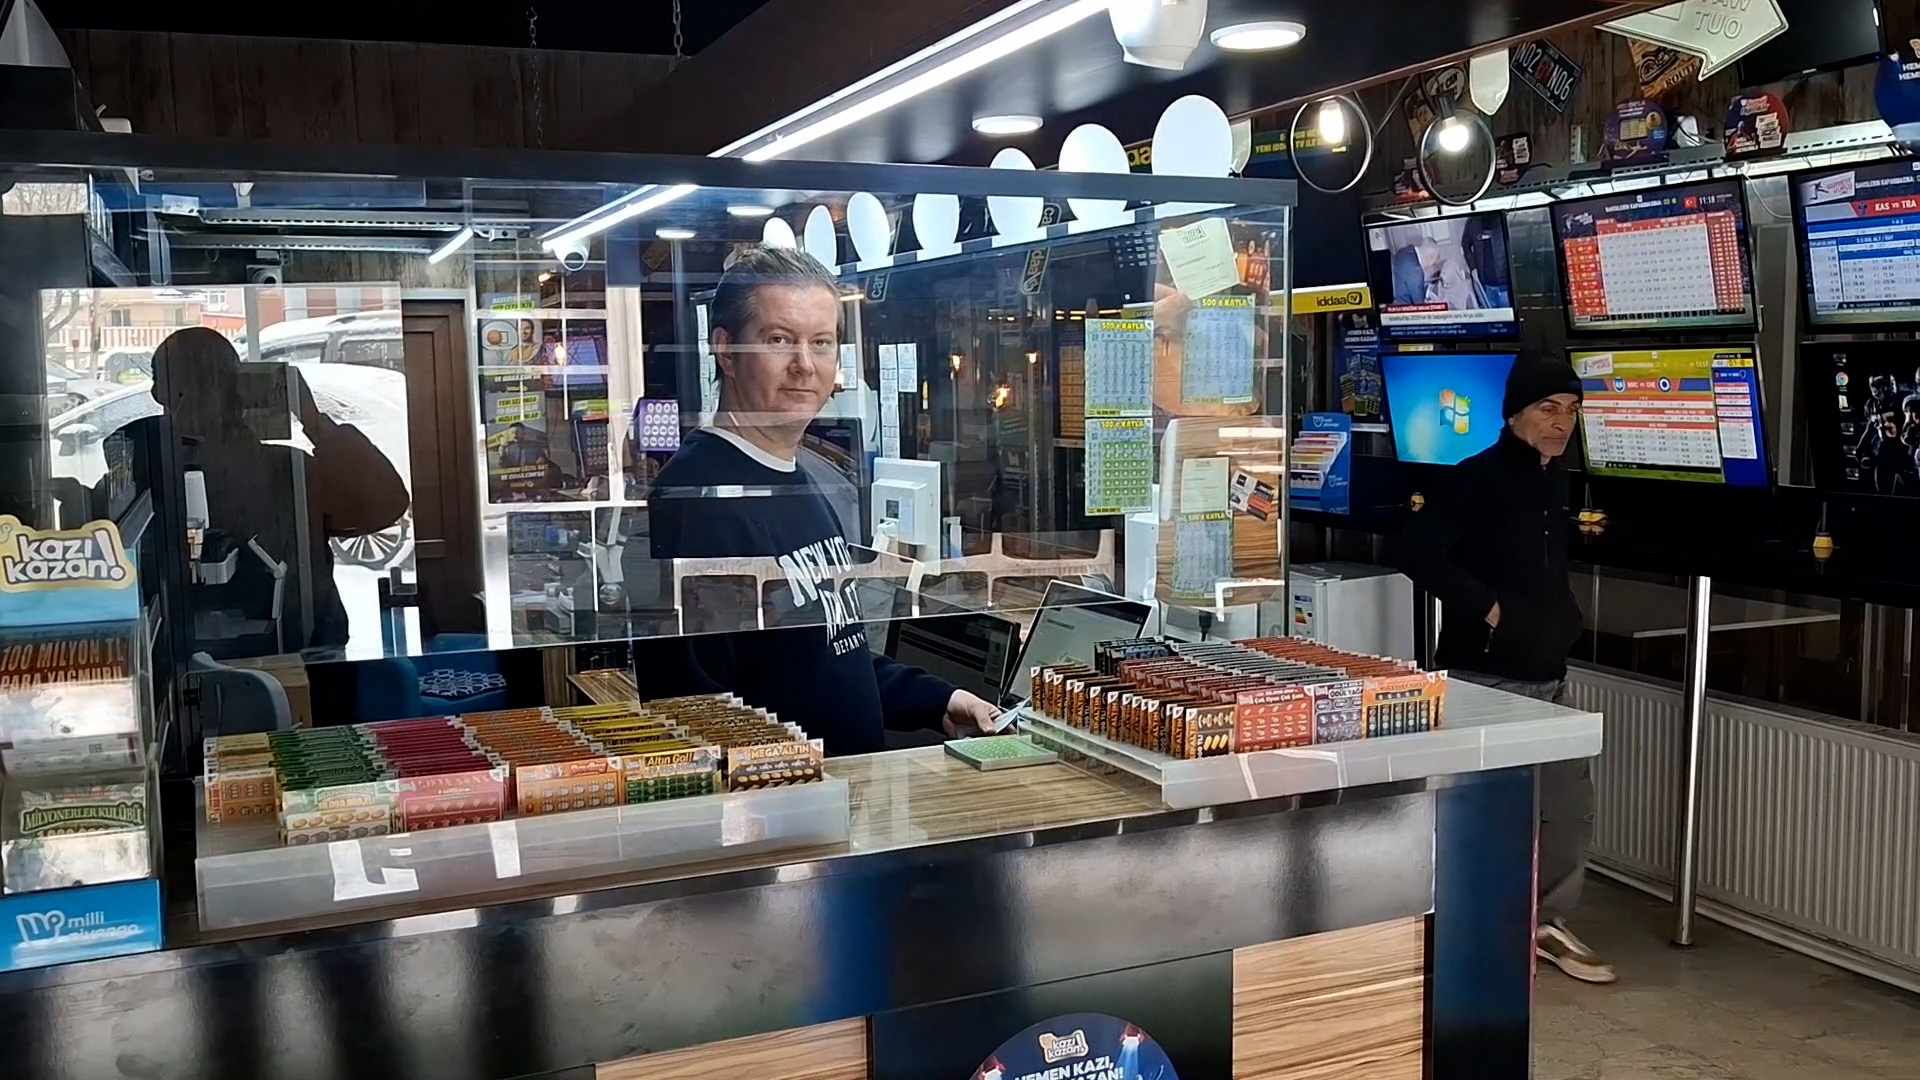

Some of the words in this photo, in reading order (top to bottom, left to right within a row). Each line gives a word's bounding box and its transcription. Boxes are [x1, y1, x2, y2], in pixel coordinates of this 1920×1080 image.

[1874, 202, 1890, 212] KAS
[1901, 200, 1917, 209] TRA
[750, 746, 780, 760] MEGA
[68, 911, 105, 928] milli
[1073, 1055, 1115, 1077] KAZI,
